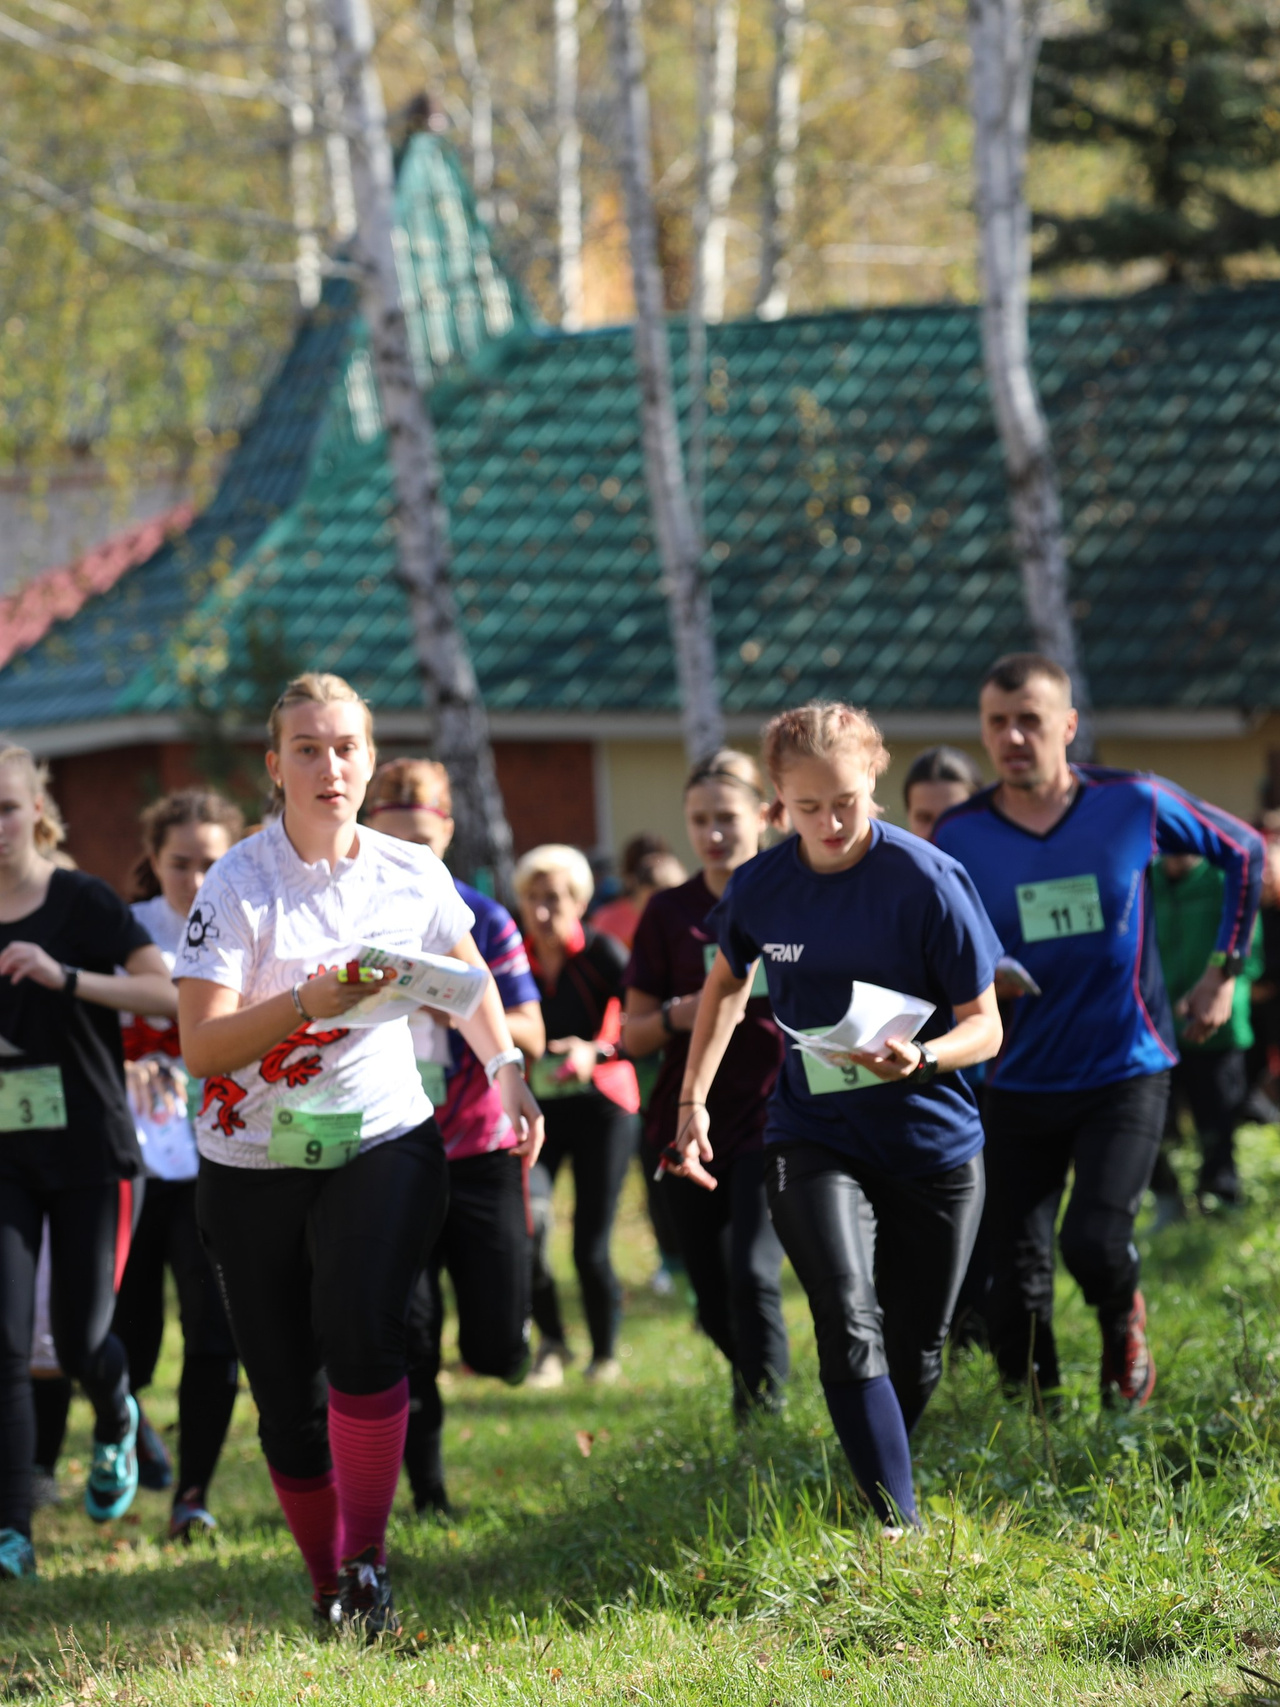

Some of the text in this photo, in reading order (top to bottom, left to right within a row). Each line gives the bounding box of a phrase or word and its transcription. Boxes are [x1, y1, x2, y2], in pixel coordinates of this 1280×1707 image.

[1049, 907, 1073, 933] 11
[20, 1098, 34, 1123] 3
[305, 1140, 322, 1165] 9
